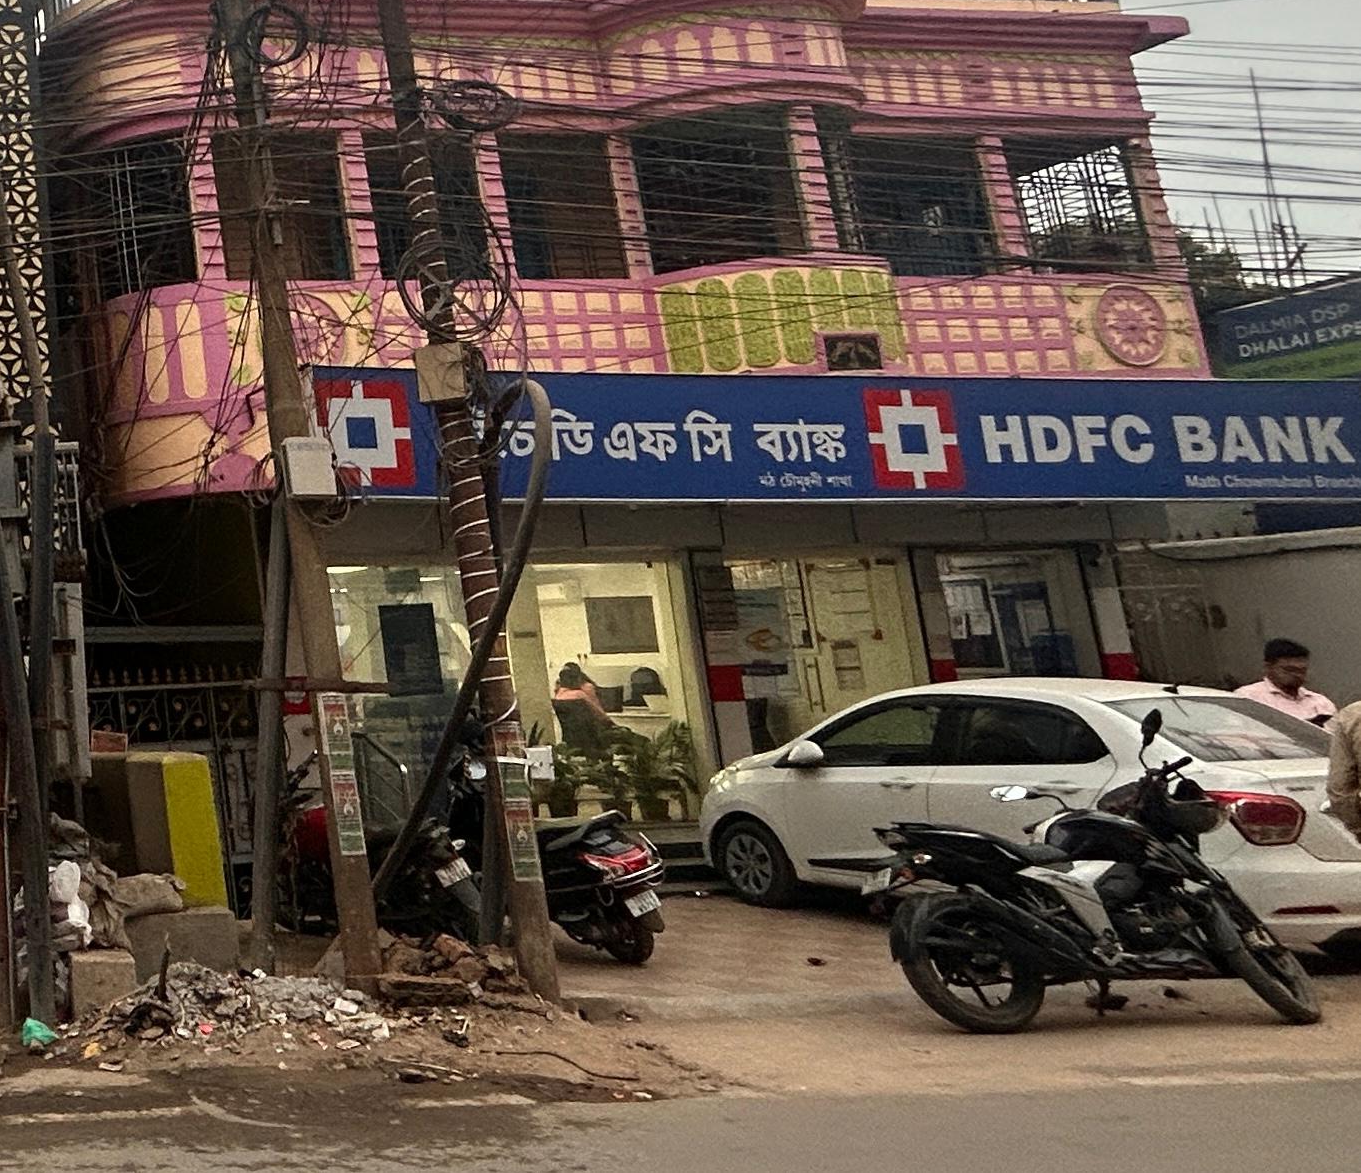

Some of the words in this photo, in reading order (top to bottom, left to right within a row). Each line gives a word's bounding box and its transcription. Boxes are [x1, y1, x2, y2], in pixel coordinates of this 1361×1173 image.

[1234, 313, 1308, 339] DALMIA
[1239, 331, 1312, 357] DHALAI
[753, 418, 847, 462] ব্যাঙ্ক
[979, 413, 1155, 464] HDFC
[1173, 415, 1357, 465] BANK
